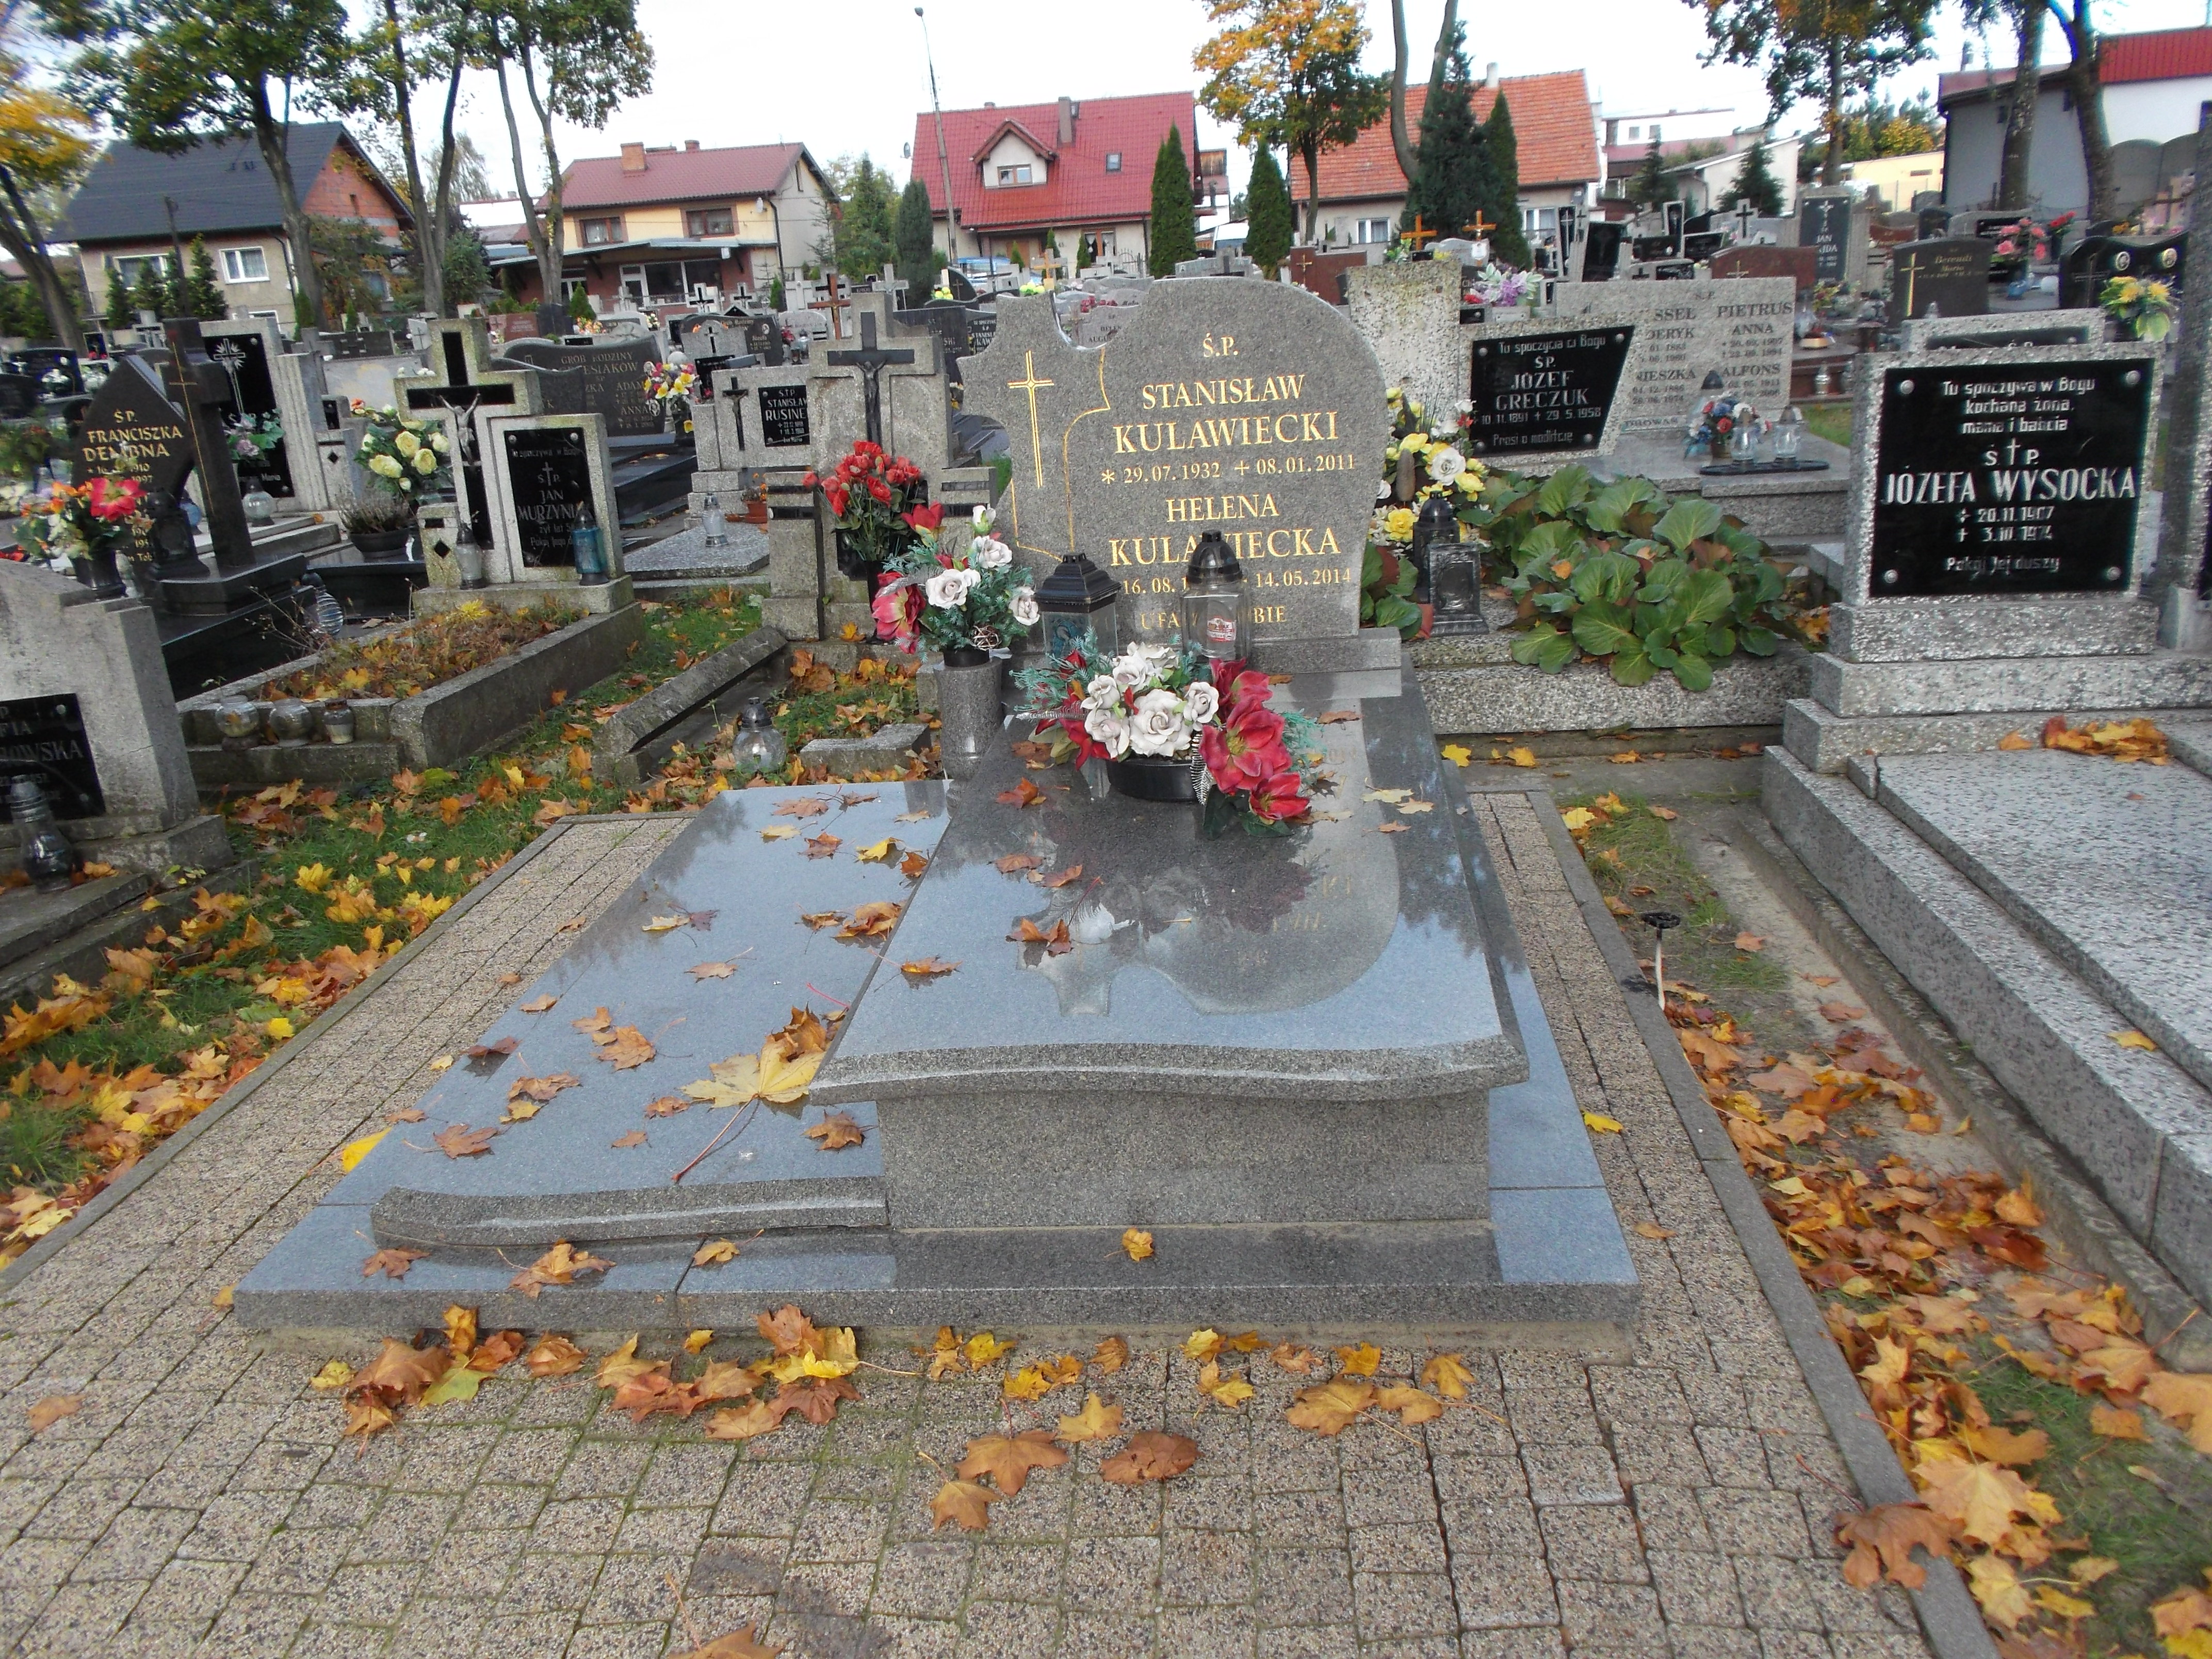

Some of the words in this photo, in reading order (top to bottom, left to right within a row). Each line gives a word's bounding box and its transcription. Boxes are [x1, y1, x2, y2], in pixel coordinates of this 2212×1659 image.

[1716, 302, 1793, 318] PIETRUS
[1732, 323, 1774, 335] ANNA
[1202, 333, 1239, 357] Ś.P.
[1580, 335, 1606, 349] Bogu
[1510, 369, 1574, 390] JÓZEF
[1722, 363, 1781, 377] ALFONS
[1142, 373, 1306, 410] STANISŁAW
[1942, 380, 1958, 397] Tu
[2040, 381, 2055, 393] w
[2059, 377, 2095, 395] Bogu
[1495, 388, 1589, 411] GRECZUK
[1965, 398, 2027, 414] kochana
[766, 408, 806, 421] RUSINE
[87, 425, 183, 444] FRANCISZKA
[1113, 411, 1339, 453] KULAWIECKI
[1962, 419, 2005, 434] mama
[2019, 416, 2069, 432] babcia
[1124, 462, 1221, 484] 29.07.1932
[1256, 453, 1355, 476] 08.01.2011
[1881, 464, 1977, 505] JÓZEFA
[1993, 466, 2136, 502] WYSOCKA
[541, 490, 563, 504] JAN
[517, 503, 578, 521] MURZYNI
[1165, 493, 1280, 523] HELENA
[1256, 568, 1352, 589] 14.05.2014
